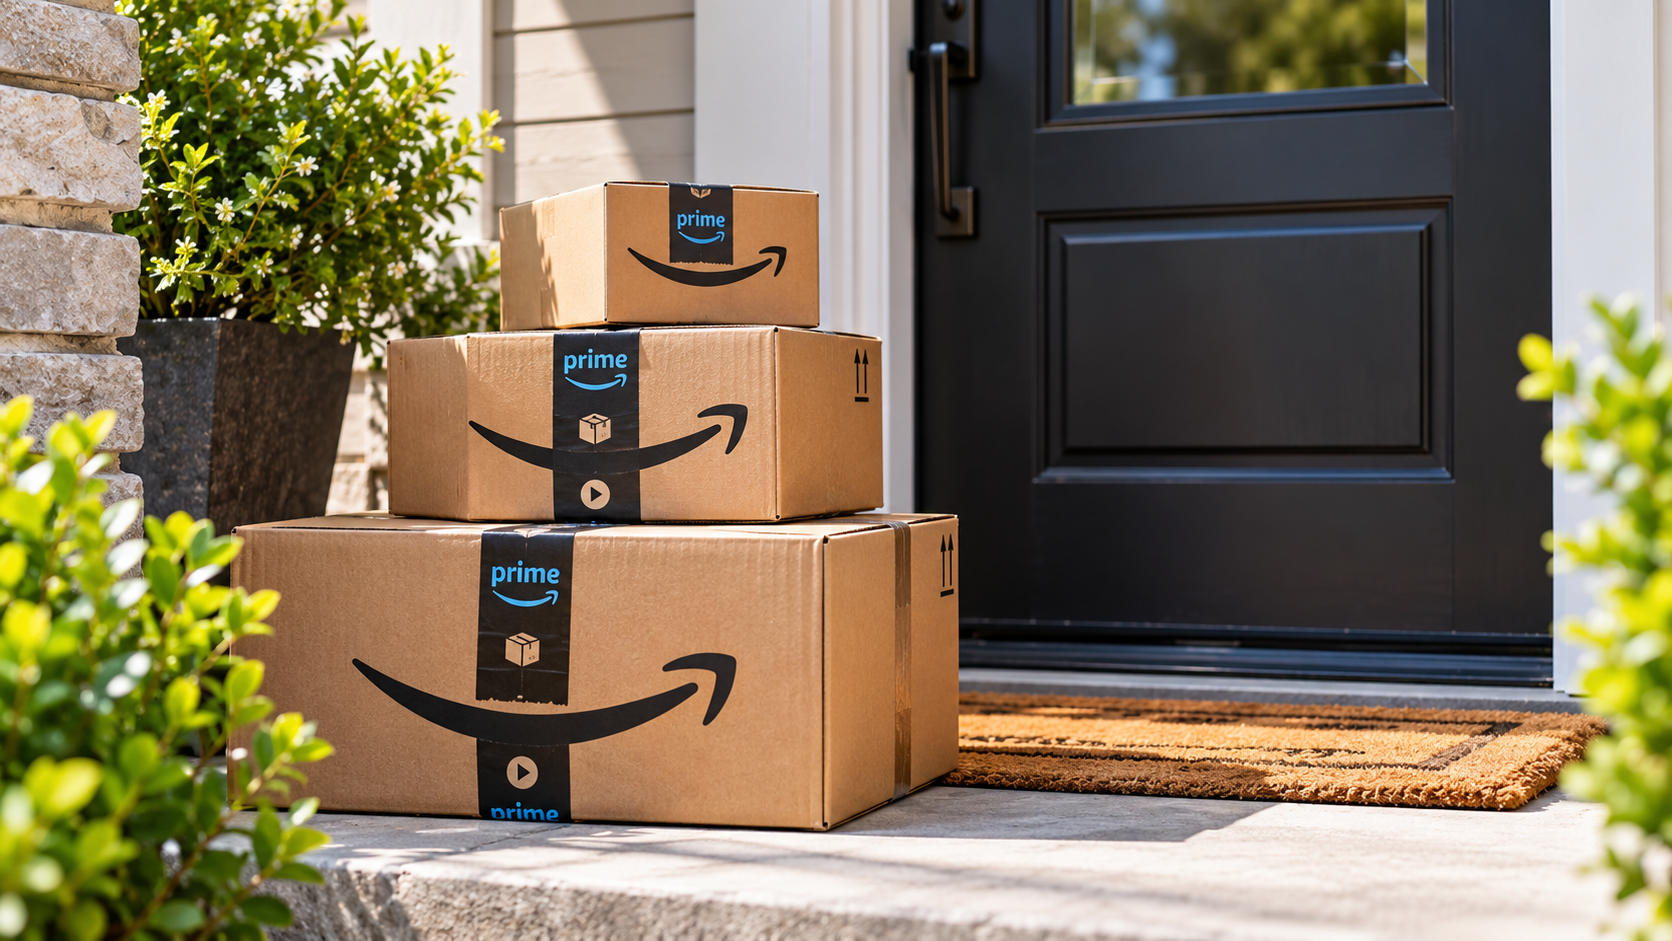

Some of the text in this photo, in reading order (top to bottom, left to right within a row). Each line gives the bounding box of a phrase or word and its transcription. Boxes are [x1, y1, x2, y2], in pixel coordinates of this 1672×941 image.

[677, 209, 726, 230] prime
[563, 348, 628, 375] prime
[491, 560, 561, 588] prime
